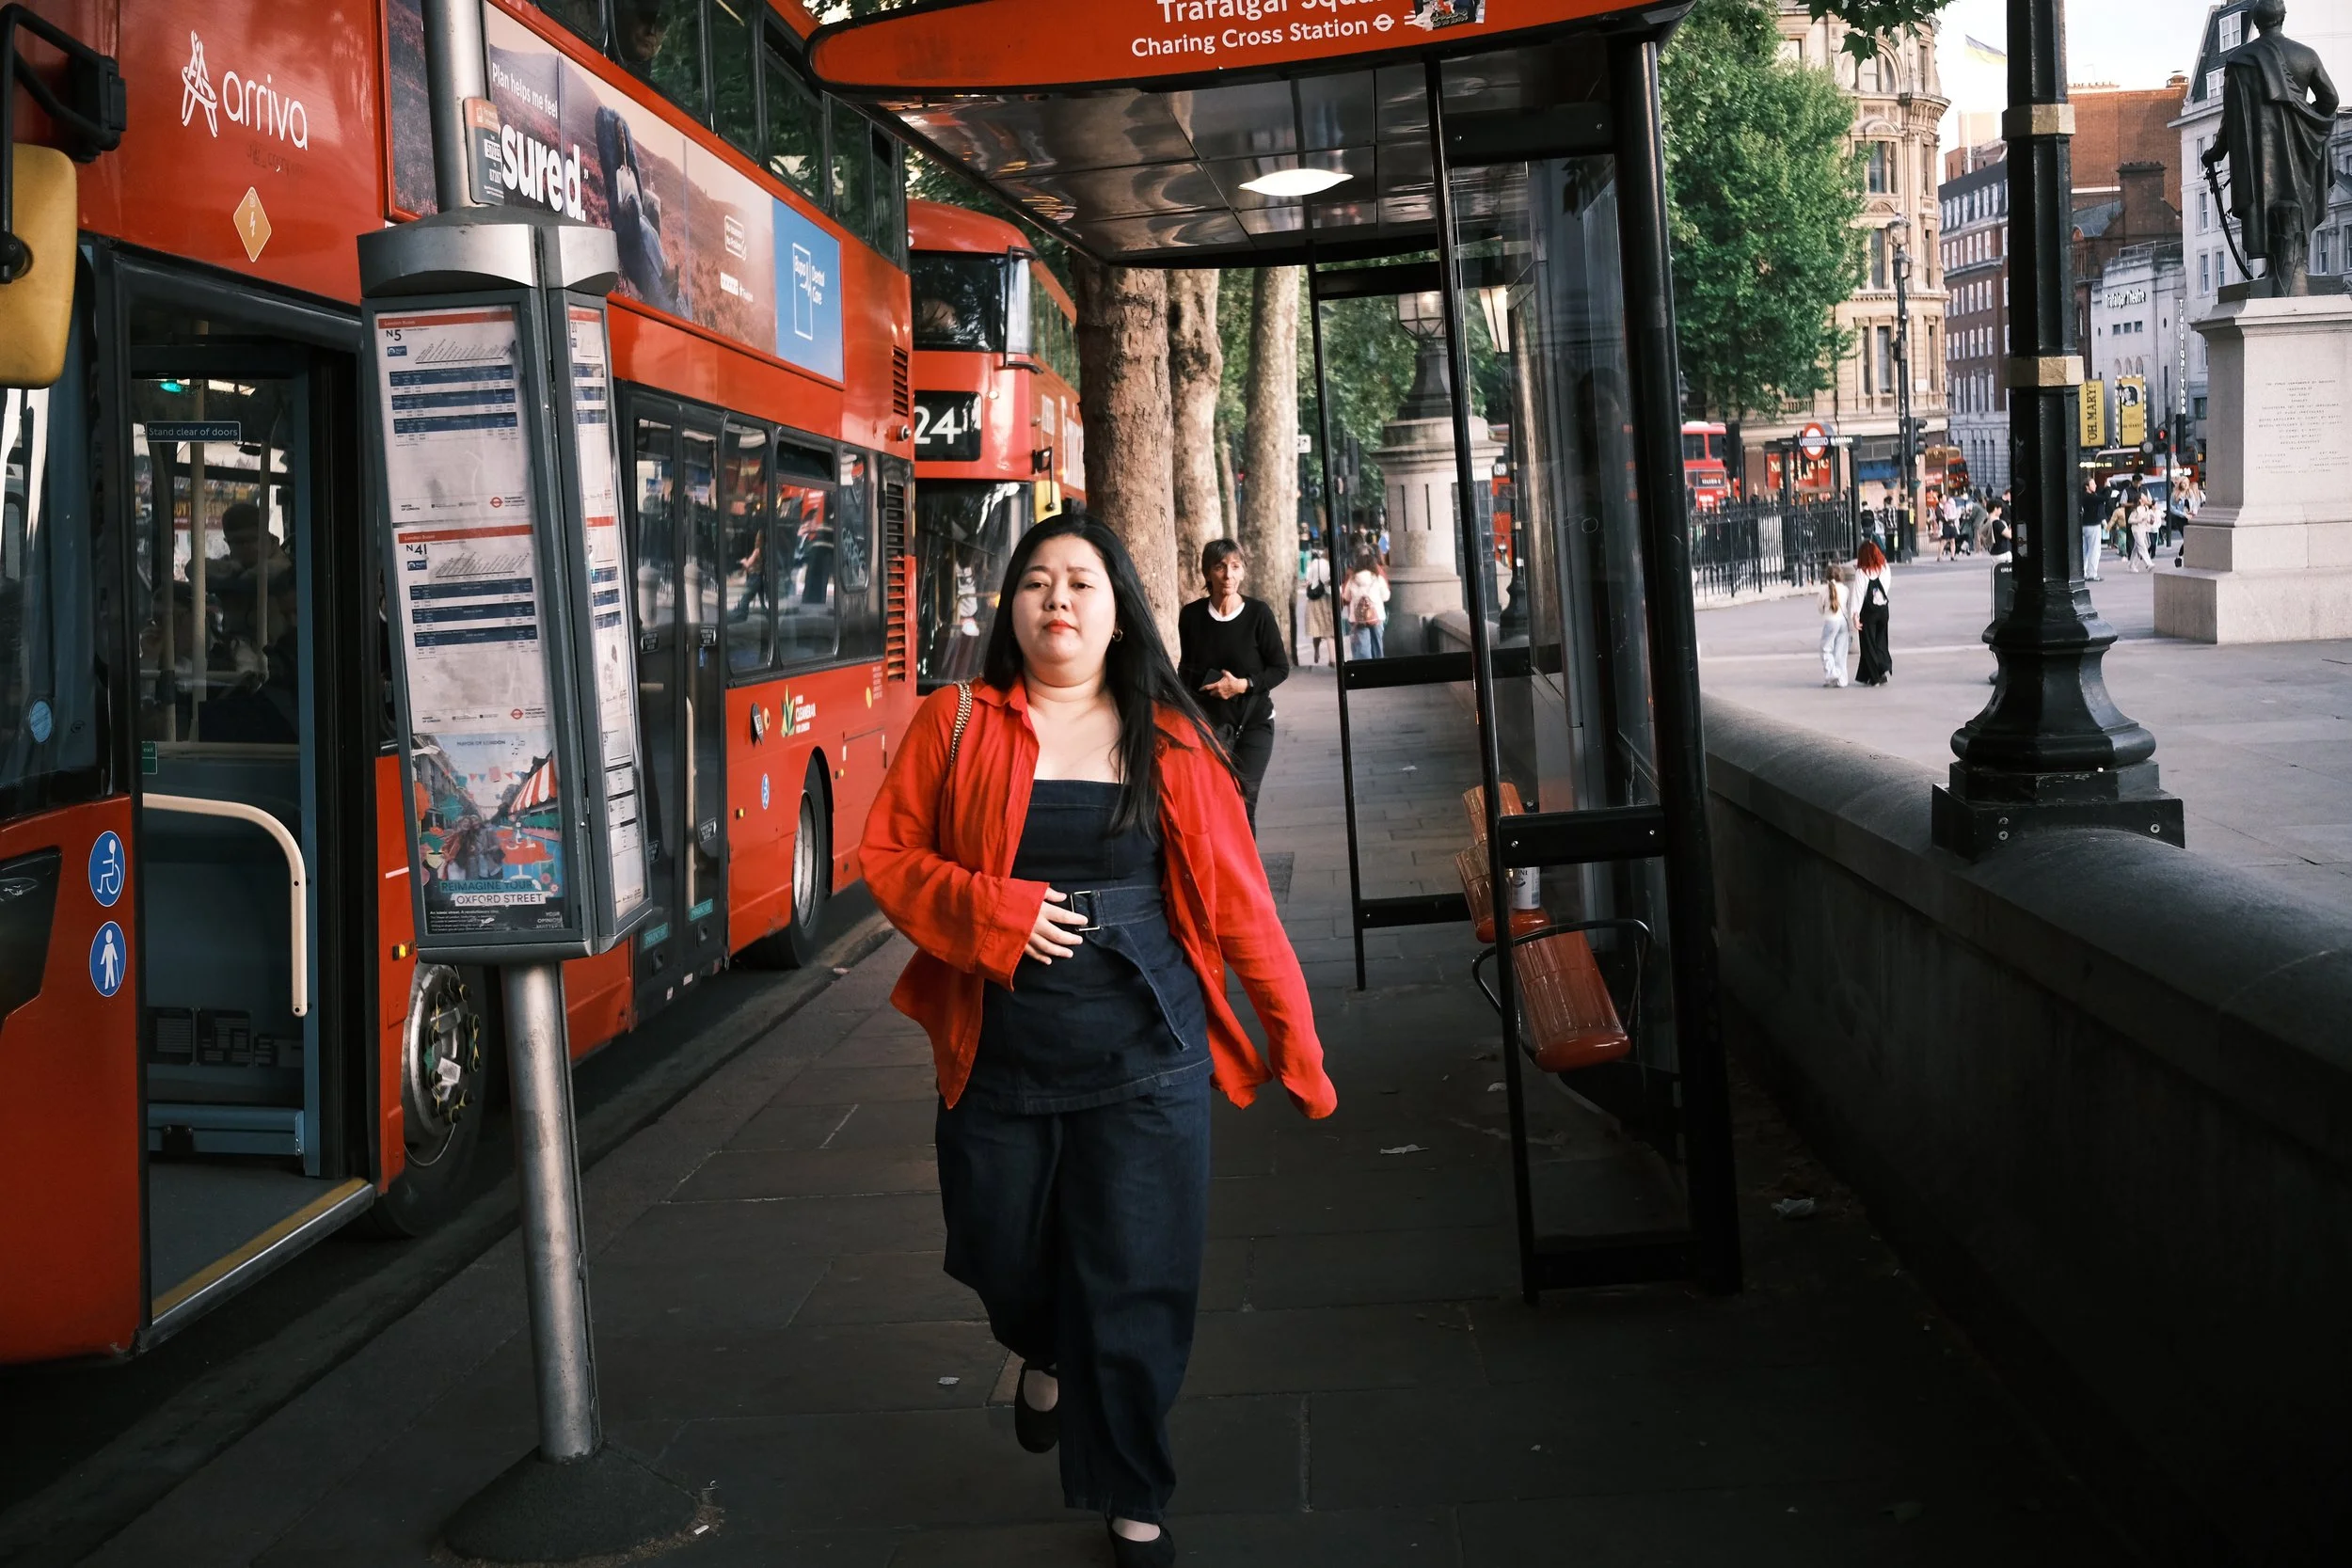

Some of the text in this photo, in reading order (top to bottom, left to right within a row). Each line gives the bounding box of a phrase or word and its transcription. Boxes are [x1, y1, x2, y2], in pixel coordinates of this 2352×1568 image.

[1157, 0, 1289, 23] Trafalgar
[1132, 19, 1368, 57] Charing Cross Station
[492, 62, 558, 119] Plan helps me feel
[223, 71, 308, 151] arriva
[2106, 288, 2145, 309] Trafalgar Theatre
[149, 427, 238, 436] Stand clear of doors
[914, 405, 962, 445] 24
[406, 544, 427, 555] N41
[441, 879, 532, 892] REIMAGINE YOUR
[456, 894, 543, 904] OXFORD STREET
